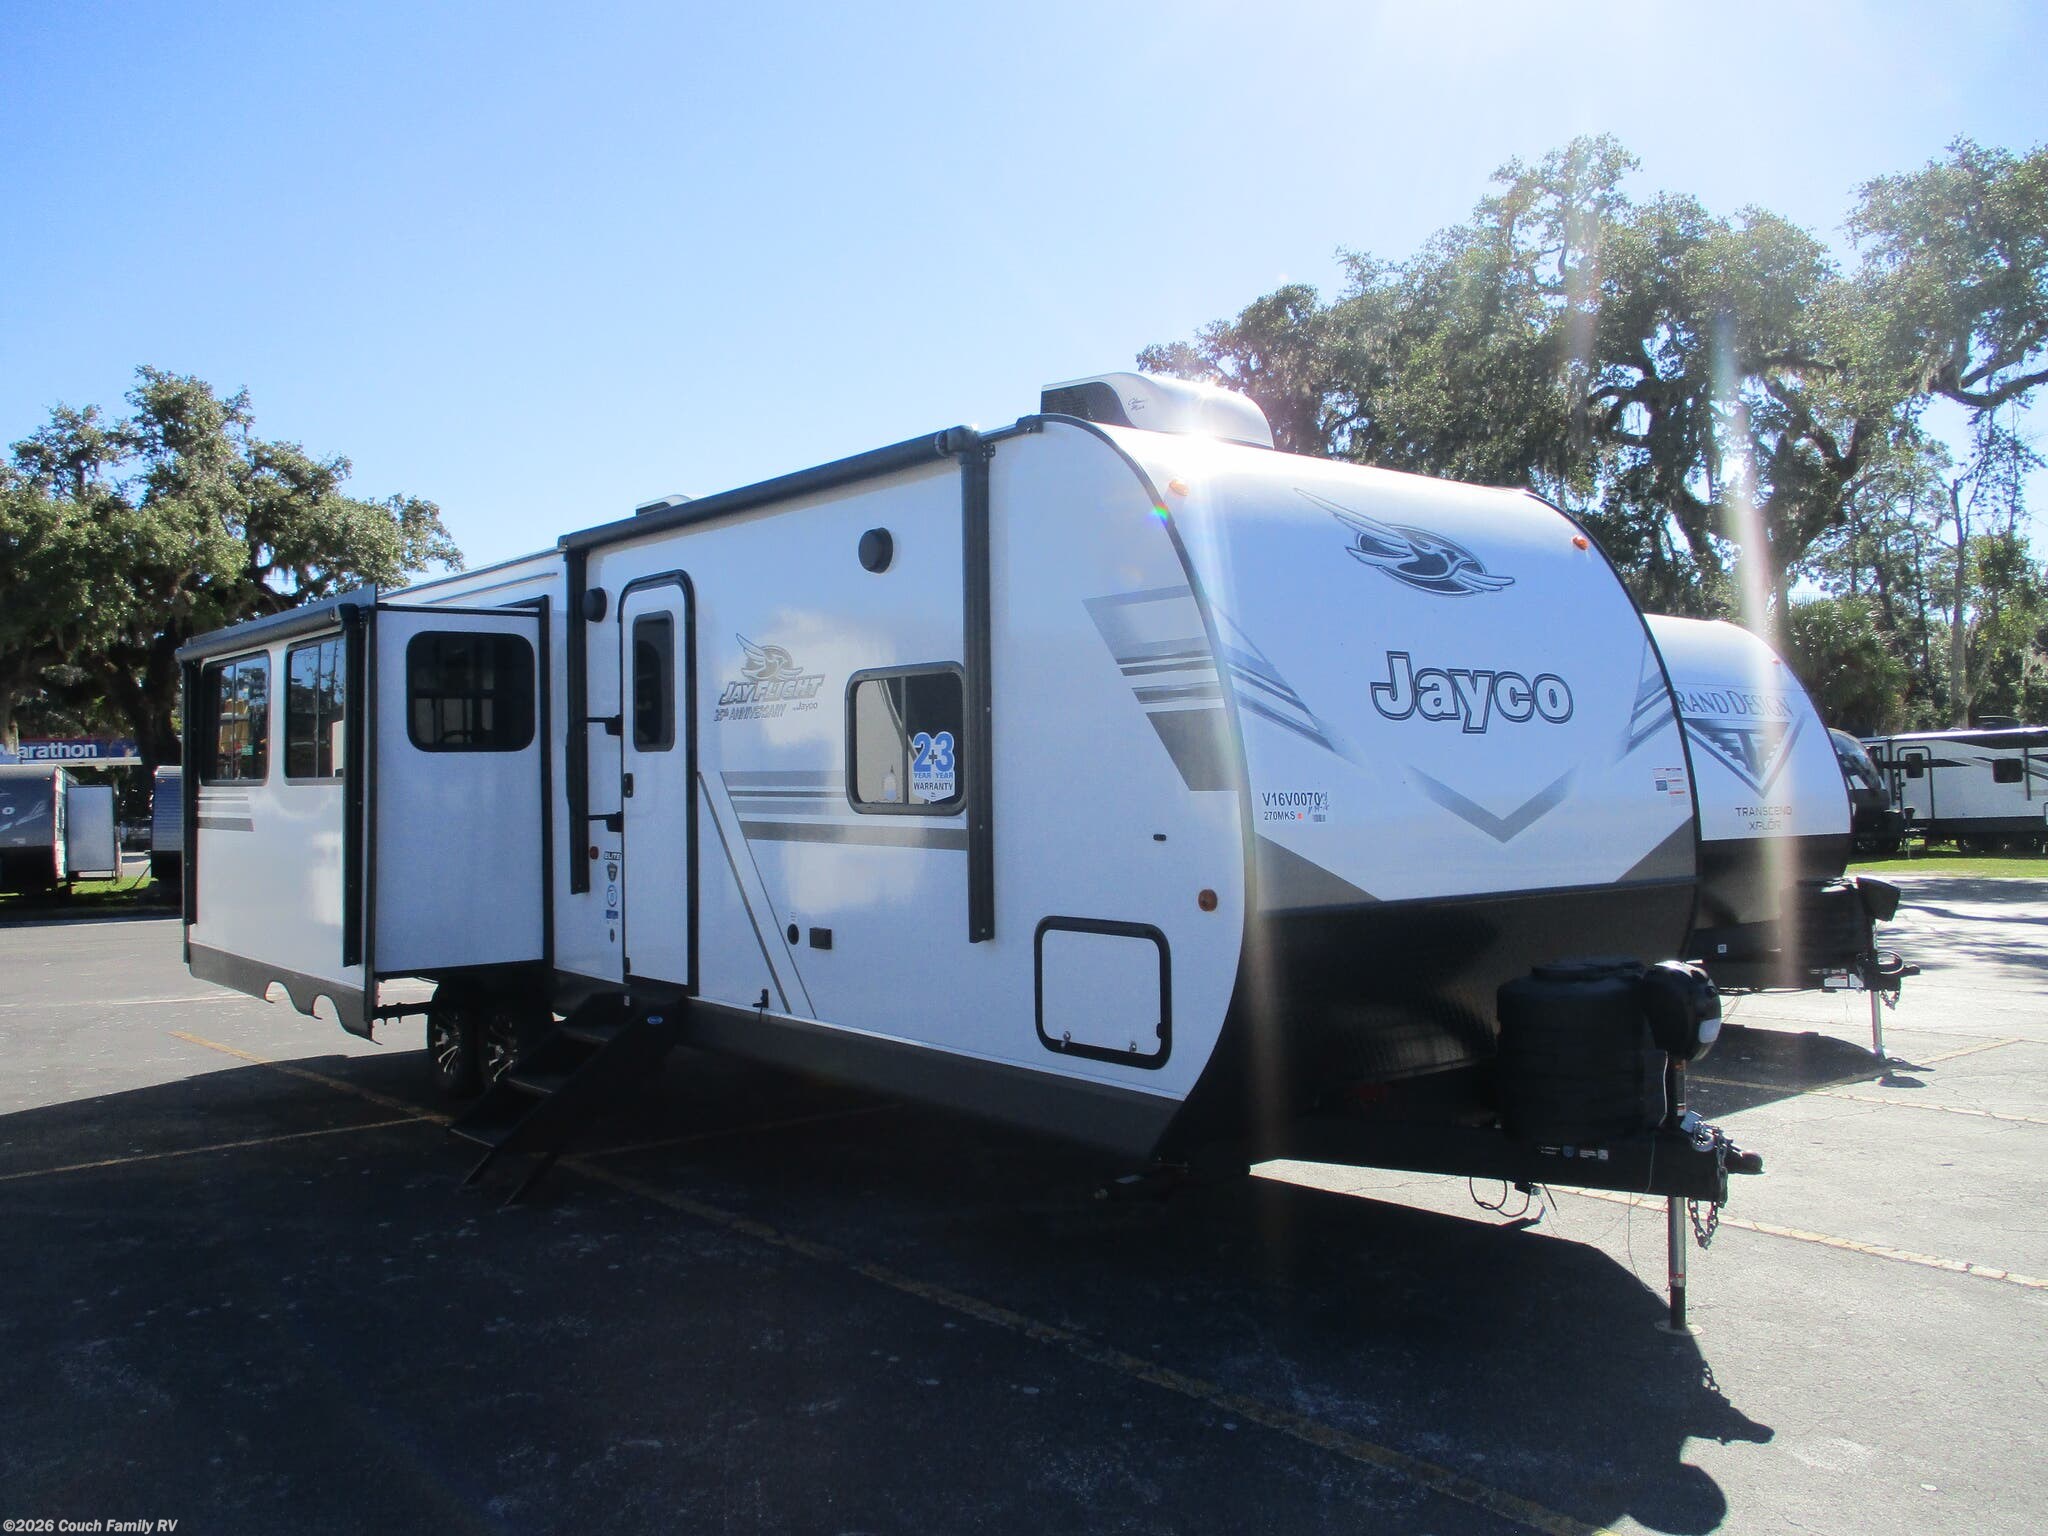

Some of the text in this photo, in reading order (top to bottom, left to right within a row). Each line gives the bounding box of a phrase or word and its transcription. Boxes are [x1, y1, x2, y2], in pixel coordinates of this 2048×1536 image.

[1370, 650, 1574, 734] Jayco
[1673, 690, 1793, 717] RAND DESIGN
[914, 782, 952, 790] WARRANTY
[1264, 811, 1296, 821] 270MKS
